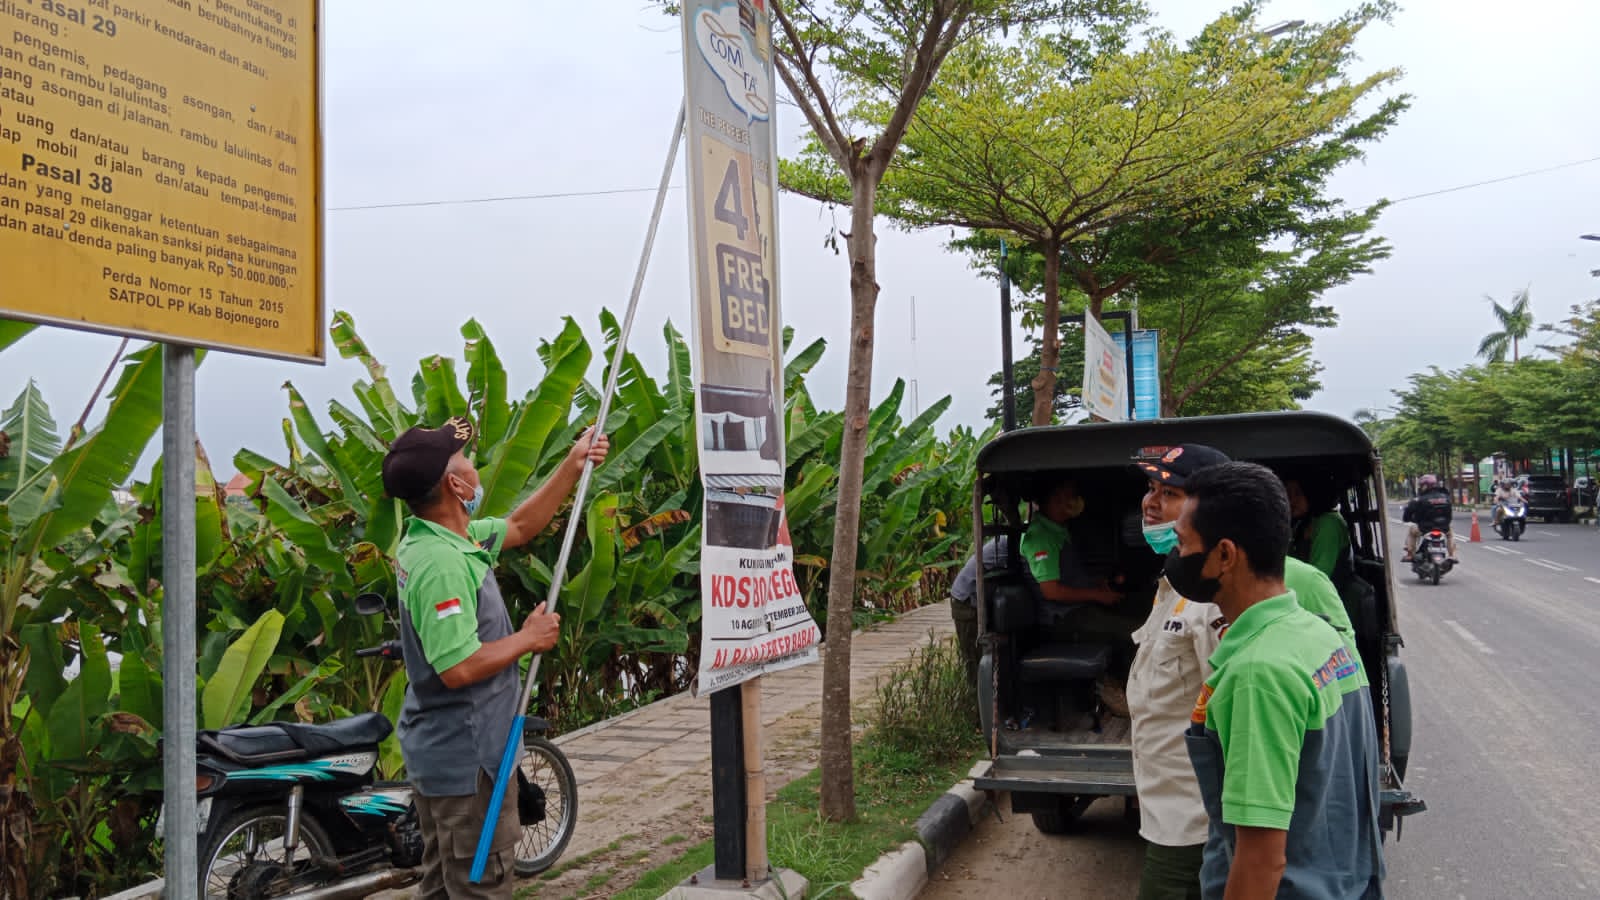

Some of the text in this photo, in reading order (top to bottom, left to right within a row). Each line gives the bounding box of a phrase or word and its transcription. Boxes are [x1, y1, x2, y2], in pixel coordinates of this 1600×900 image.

[92, 14, 117, 37] 29
[113, 4, 152, 28] parkir
[154, 18, 216, 57] kendaraan
[218, 48, 240, 67] dan
[198, 5, 263, 45] berubahnya
[265, 36, 297, 60] fungsi
[13, 30, 90, 71] pengemis,
[103, 63, 168, 99] pedagang
[182, 94, 236, 124] asongan,
[247, 116, 267, 134] dan
[275, 128, 297, 146] atau
[28, 54, 56, 74] dan
[60, 66, 106, 93] rambu
[16, 110, 297, 210] uang dan/atau barang kepada pengemis,
[41, 79, 104, 110] asongan
[107, 101, 120, 115] di
[180, 126, 219, 150] rambu
[224, 139, 273, 169] lalulintas
[278, 160, 297, 177] dan
[21, 153, 113, 194] Pasal 38
[36, 137, 77, 159] mobil
[94, 153, 107, 168] di
[110, 157, 143, 178] jalan
[155, 171, 209, 198] dan/atau
[220, 191, 297, 223] tempat-tempat
[714, 158, 749, 241] 4
[0, 171, 297, 260] dan yang melanggar ketentuan sebagaimana
[25, 201, 65, 221] pasal
[69, 208, 87, 225] 29
[90, 215, 159, 244] dikenakan
[162, 233, 203, 254] sanksi
[205, 244, 244, 263] pidana
[247, 252, 297, 276] kurungan
[0, 213, 294, 291] dan atau denda paling banyak Rp 50.000.000,-
[103, 266, 285, 315] Perda Nomor 15 Tahun 2015
[109, 286, 280, 329] SATPOL PP Kab Bojonegoro
[711, 573, 752, 609] KDS
